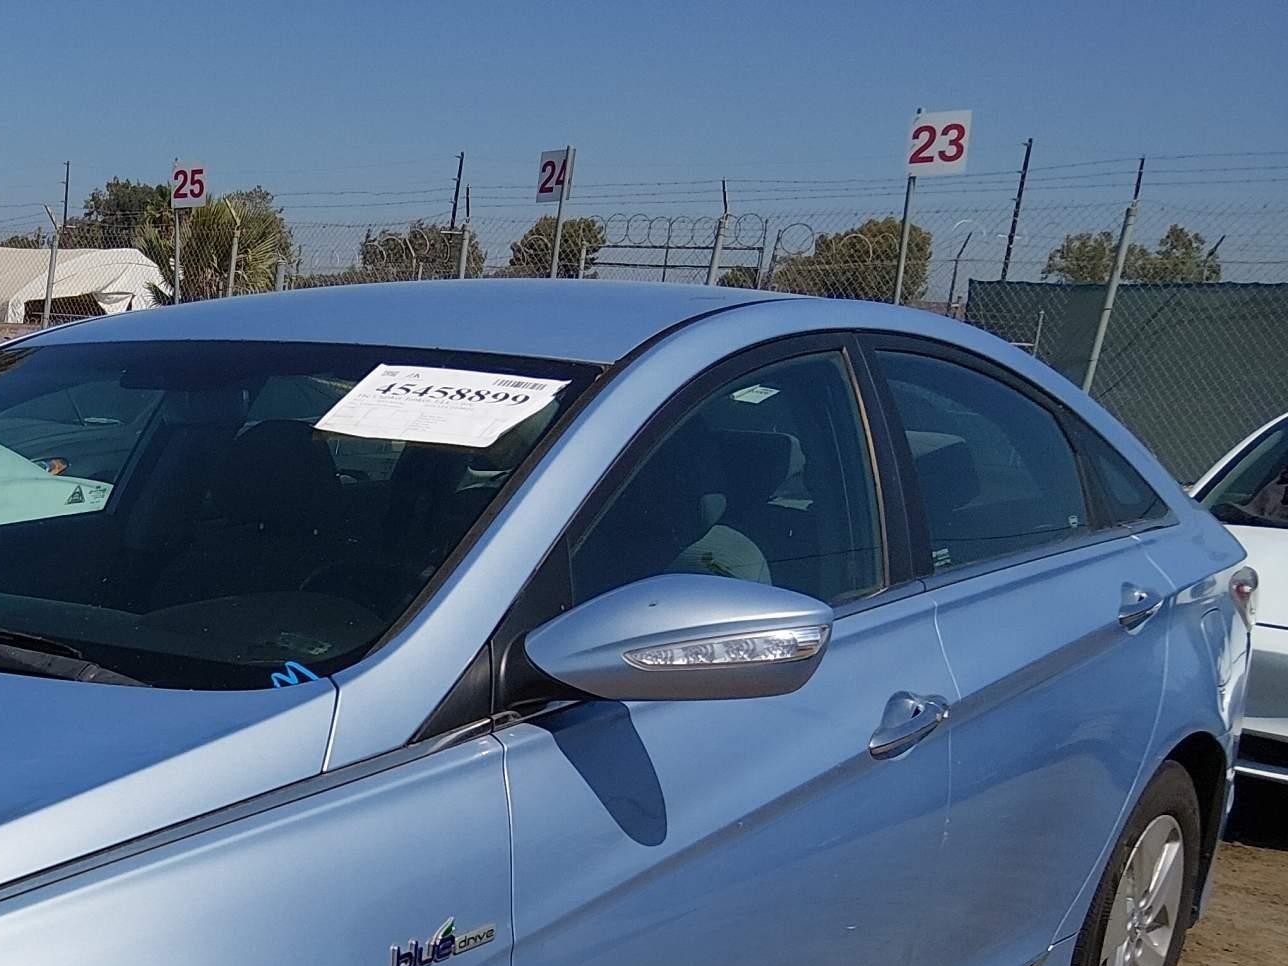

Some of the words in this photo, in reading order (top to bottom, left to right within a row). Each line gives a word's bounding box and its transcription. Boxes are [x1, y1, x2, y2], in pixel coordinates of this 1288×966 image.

[908, 123, 965, 164] 23
[174, 169, 204, 199] 25
[539, 160, 566, 193] 24
[376, 382, 530, 406] 45458899
[458, 928, 495, 950] drive
